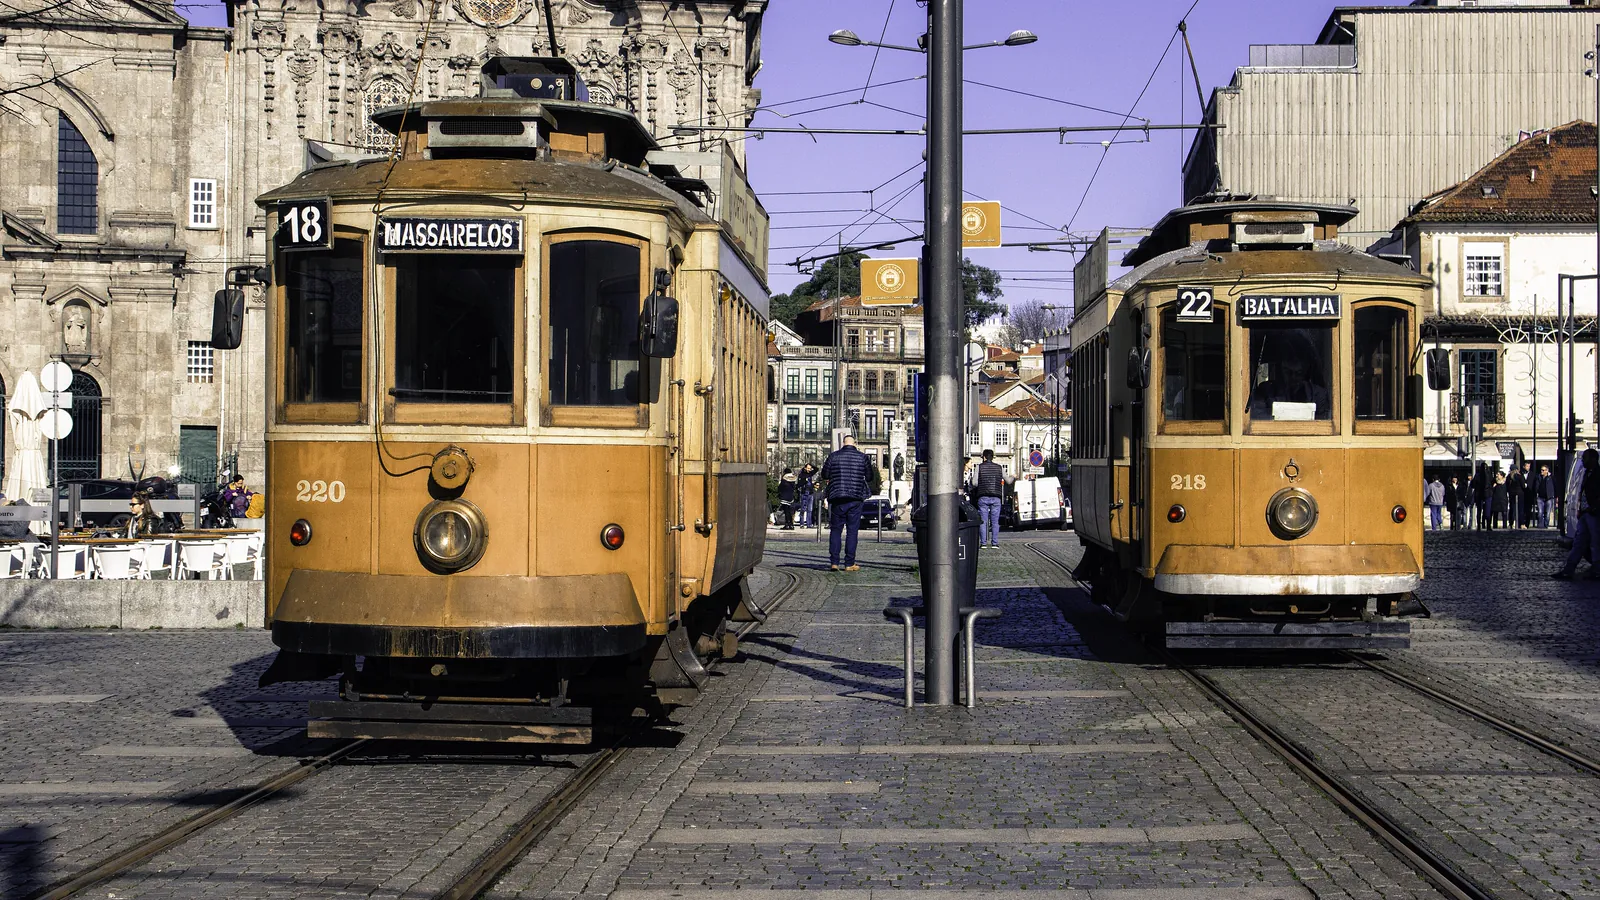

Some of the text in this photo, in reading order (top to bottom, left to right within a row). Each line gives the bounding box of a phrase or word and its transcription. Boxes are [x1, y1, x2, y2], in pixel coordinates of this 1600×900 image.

[283, 205, 322, 243] 18
[384, 222, 513, 247] MASSARELOS
[1180, 291, 1212, 317] 22
[1244, 297, 1335, 315] BATALHA
[296, 479, 346, 503] 220
[1170, 474, 1206, 490] 218
